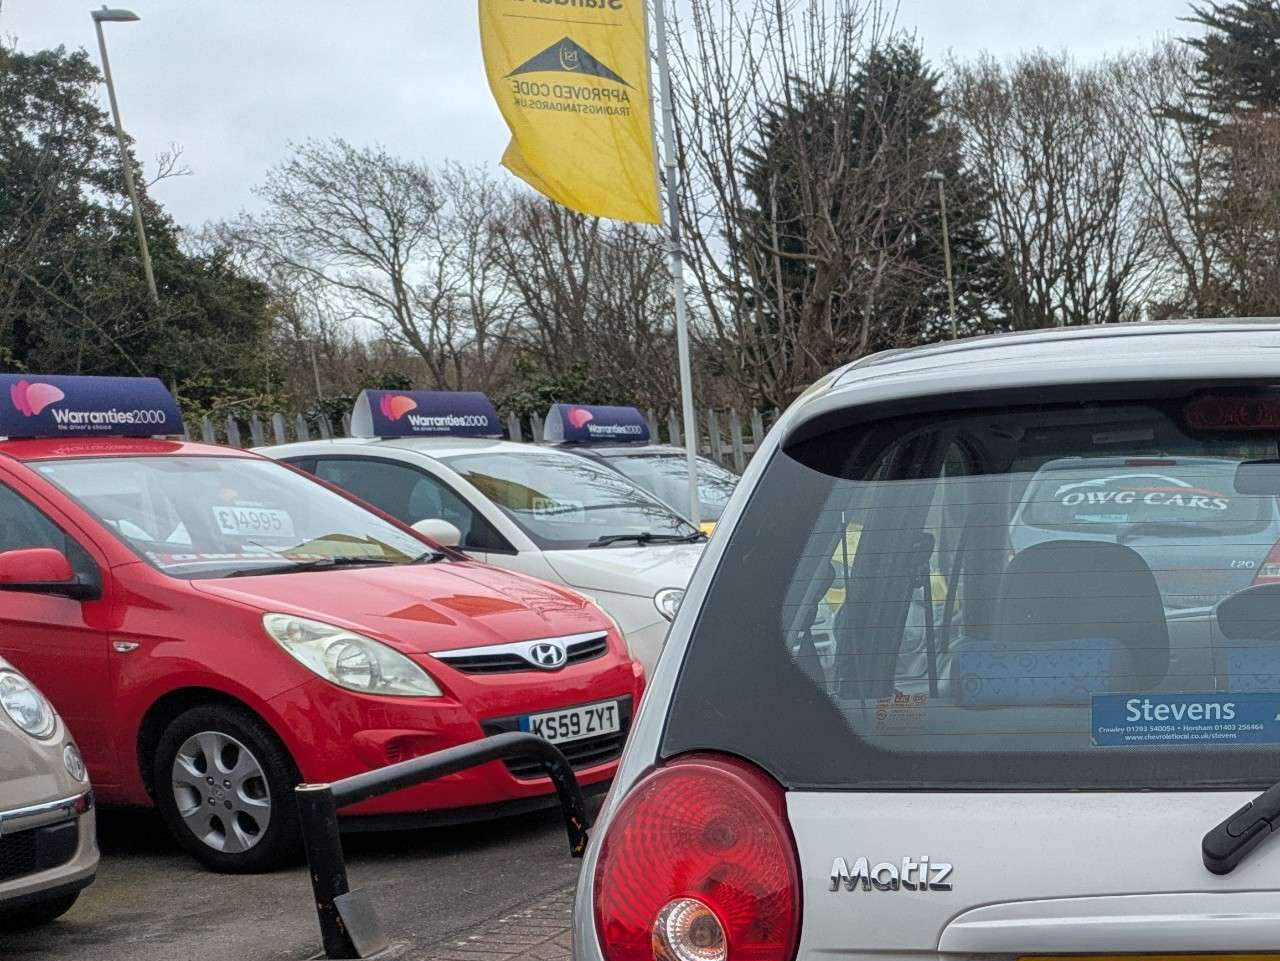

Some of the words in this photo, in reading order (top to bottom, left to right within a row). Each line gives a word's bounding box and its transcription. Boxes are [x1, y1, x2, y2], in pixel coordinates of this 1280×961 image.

[51, 408, 166, 425] Warranties2000
[407, 414, 488, 427] Warranties2000
[1061, 491, 1136, 506] OWG
[1143, 491, 1230, 511] CARS
[1126, 698, 1236, 722] Stevens
[532, 712, 581, 740] KS59
[584, 705, 615, 733] ZYT
[829, 855, 953, 892] Matiz
